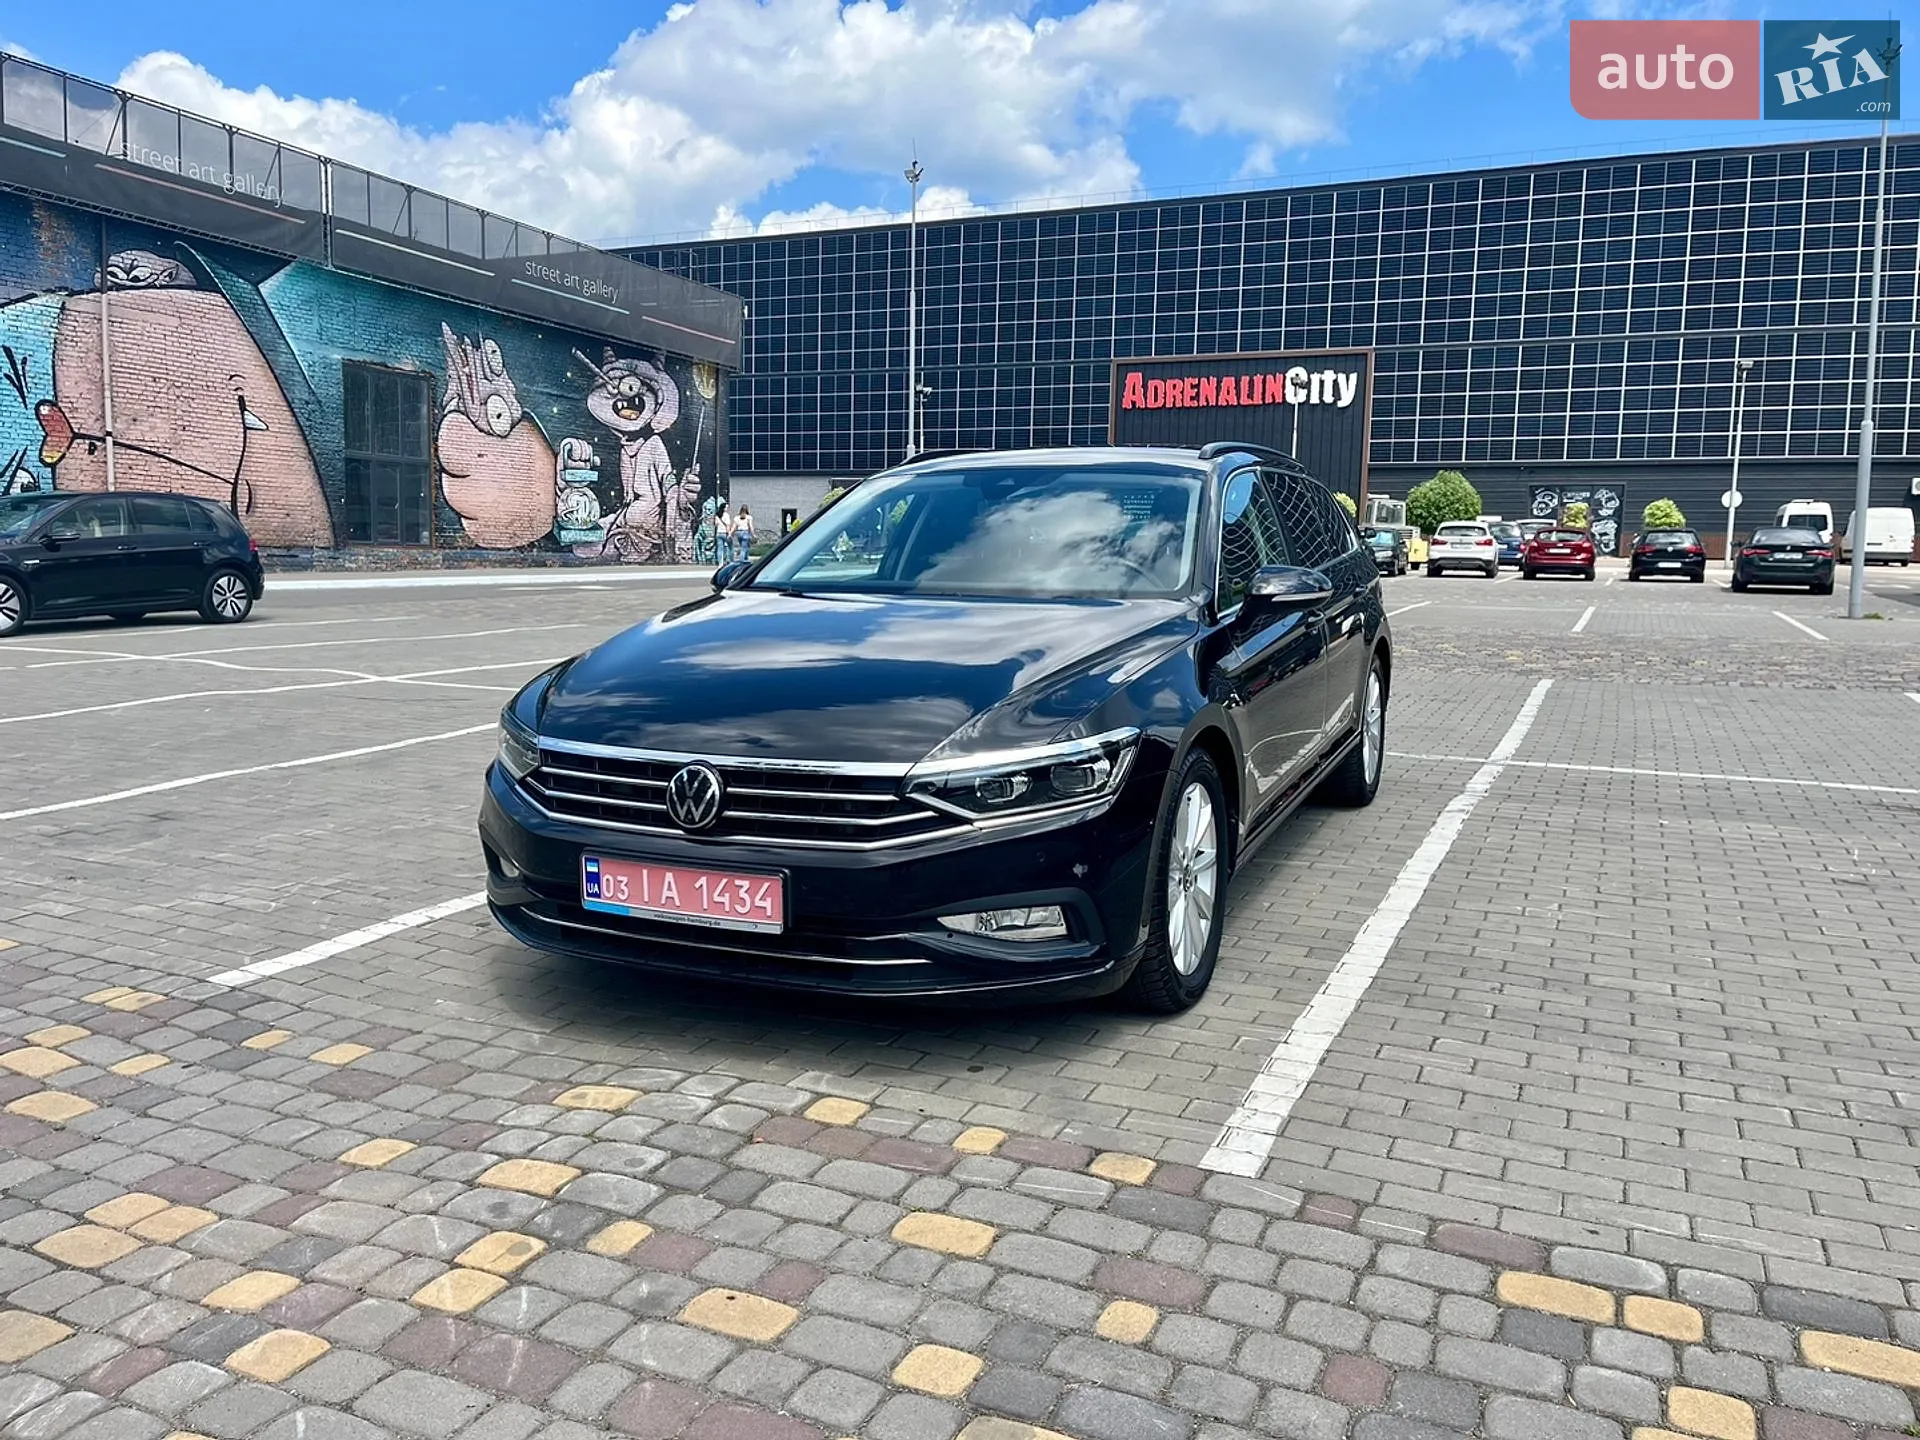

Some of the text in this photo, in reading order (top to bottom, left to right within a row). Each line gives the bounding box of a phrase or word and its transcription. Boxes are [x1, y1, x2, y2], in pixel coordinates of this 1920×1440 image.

[121, 142, 285, 208] street art gallery
[525, 260, 619, 304] street art gallery
[587, 882, 600, 895] UA
[602, 873, 630, 901] 03
[693, 875, 772, 917] 1434
